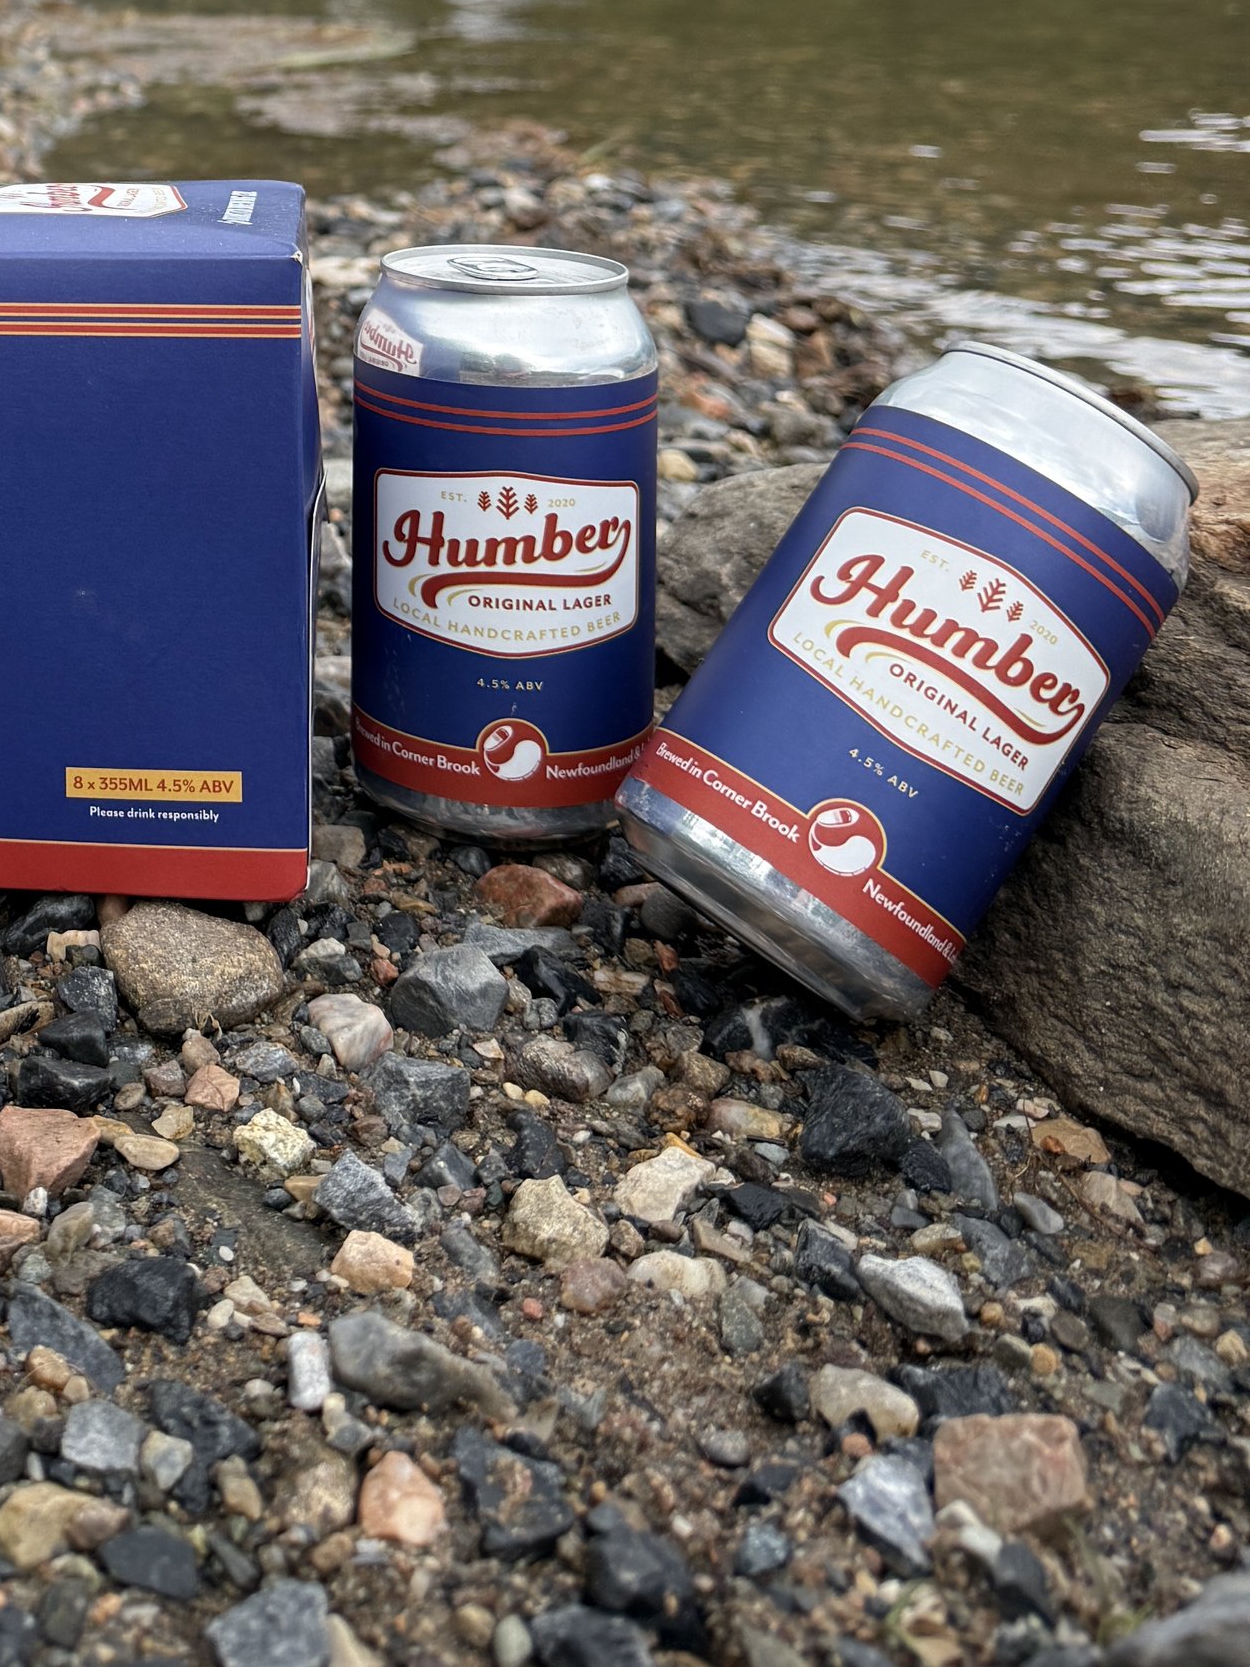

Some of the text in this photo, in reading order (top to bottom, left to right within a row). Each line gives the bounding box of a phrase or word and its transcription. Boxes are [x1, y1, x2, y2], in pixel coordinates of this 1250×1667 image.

[441, 490, 576, 508] EST. 2020
[382, 509, 631, 567] Humber
[393, 597, 622, 641] LOCAL HANDCRAFTED BEER
[468, 593, 612, 611] ORIGINAL LAGER
[921, 549, 1058, 645] EST. 2020
[810, 554, 1085, 719] Humber
[477, 678, 544, 691] 4.5% ABV
[793, 632, 1025, 796] LOCAL HANDCRAFTED BEER
[889, 663, 1029, 771] ORIGINAL LAGER
[381, 736, 391, 751] in
[392, 741, 434, 766] Corner
[436, 755, 481, 775] Brook
[546, 749, 634, 779] Newfoundland
[848, 748, 919, 798] 4.5% ABV
[73, 776, 234, 794] 8 x 355ML 4.5% ABV
[89, 806, 219, 823] Please drink responsibly
[655, 742, 694, 771] Brewed
[689, 761, 703, 779] in
[702, 769, 753, 809] Corner
[750, 800, 800, 843] Brook
[862, 878, 947, 952] Newfoundland
